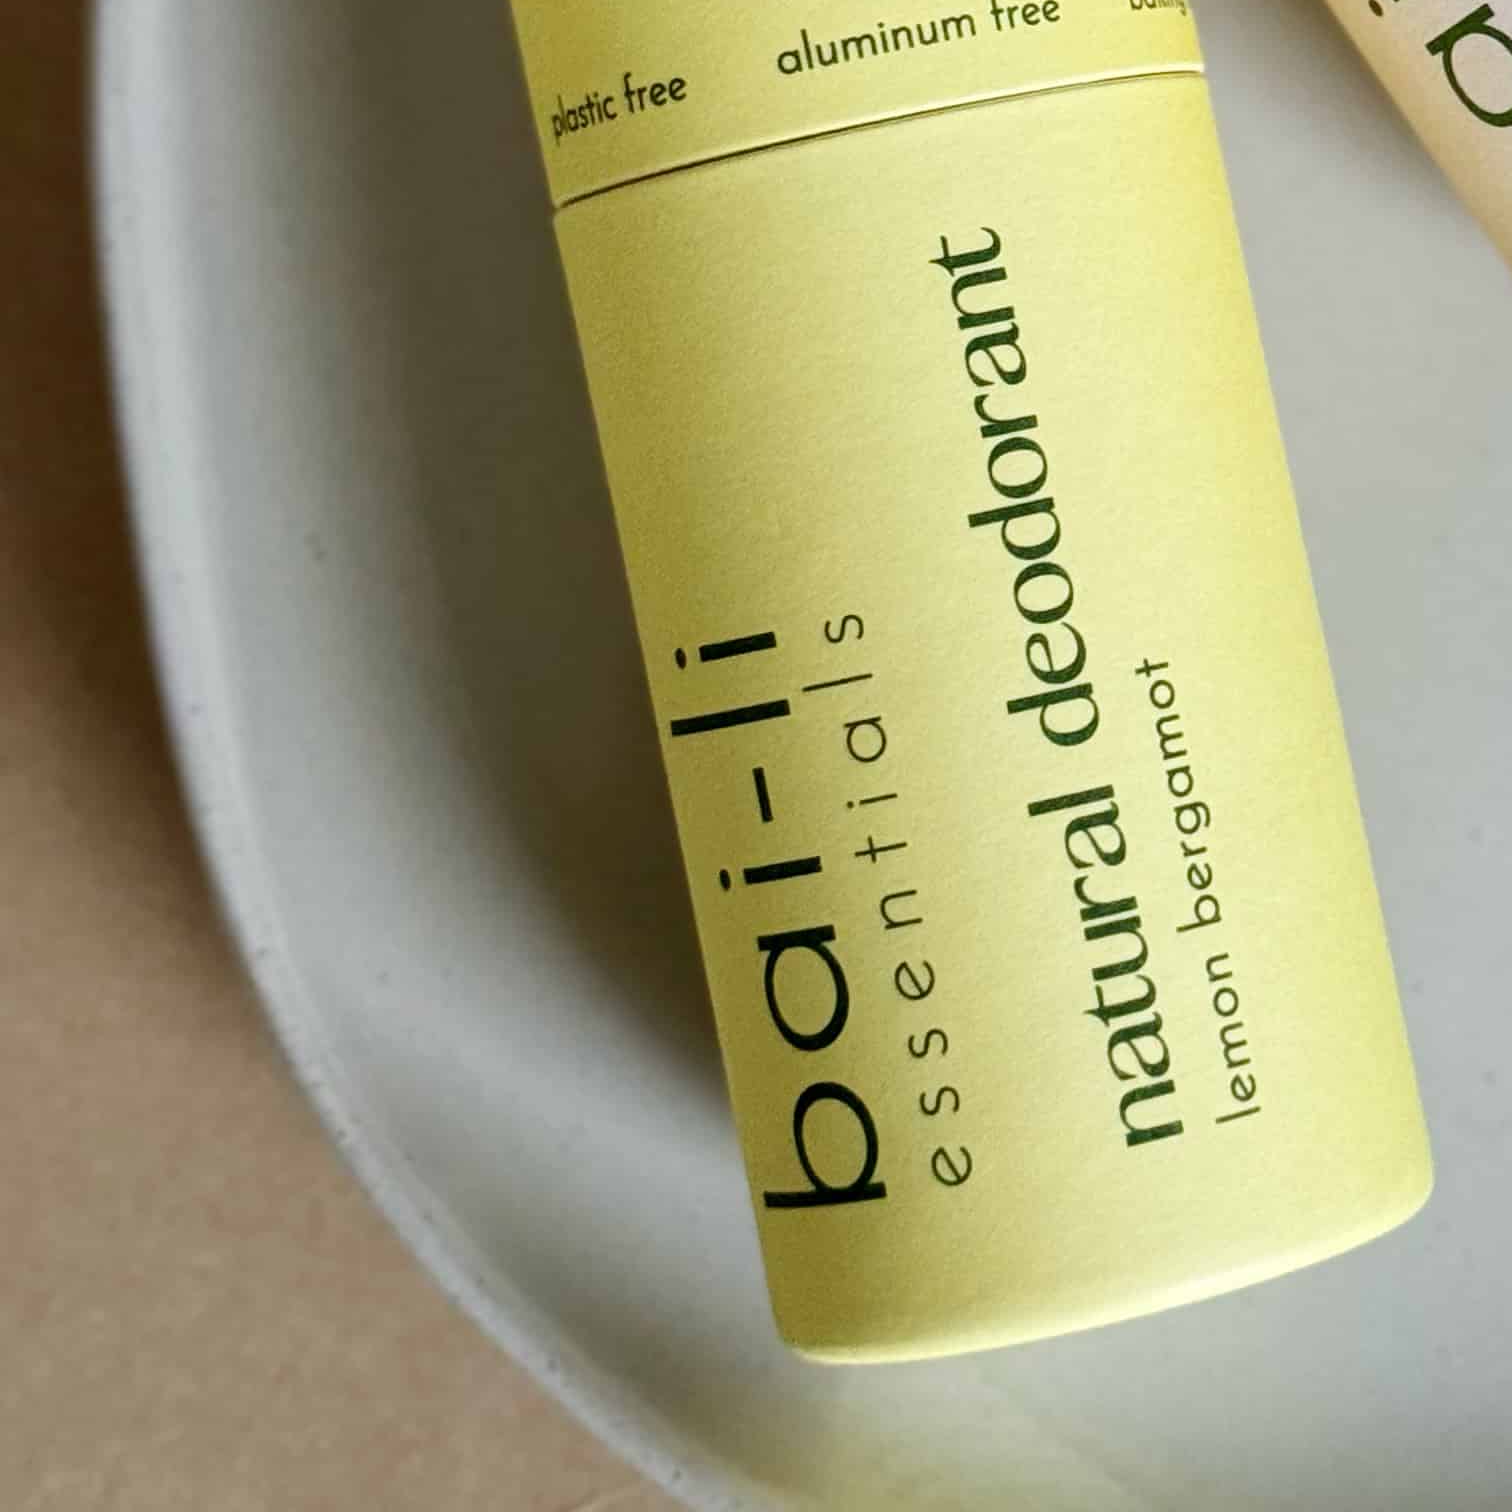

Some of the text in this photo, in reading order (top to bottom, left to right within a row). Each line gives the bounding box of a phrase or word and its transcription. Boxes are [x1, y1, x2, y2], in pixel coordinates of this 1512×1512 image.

[551, 92, 618, 147] plastic
[623, 71, 687, 114] free
[777, 9, 978, 76] aluminum
[670, 631, 888, 1209] bai-li
[802, 613, 973, 1188] essentials
[929, 226, 1184, 1148] natural deodorant
[1135, 656, 1261, 1123] lemon bergamot
